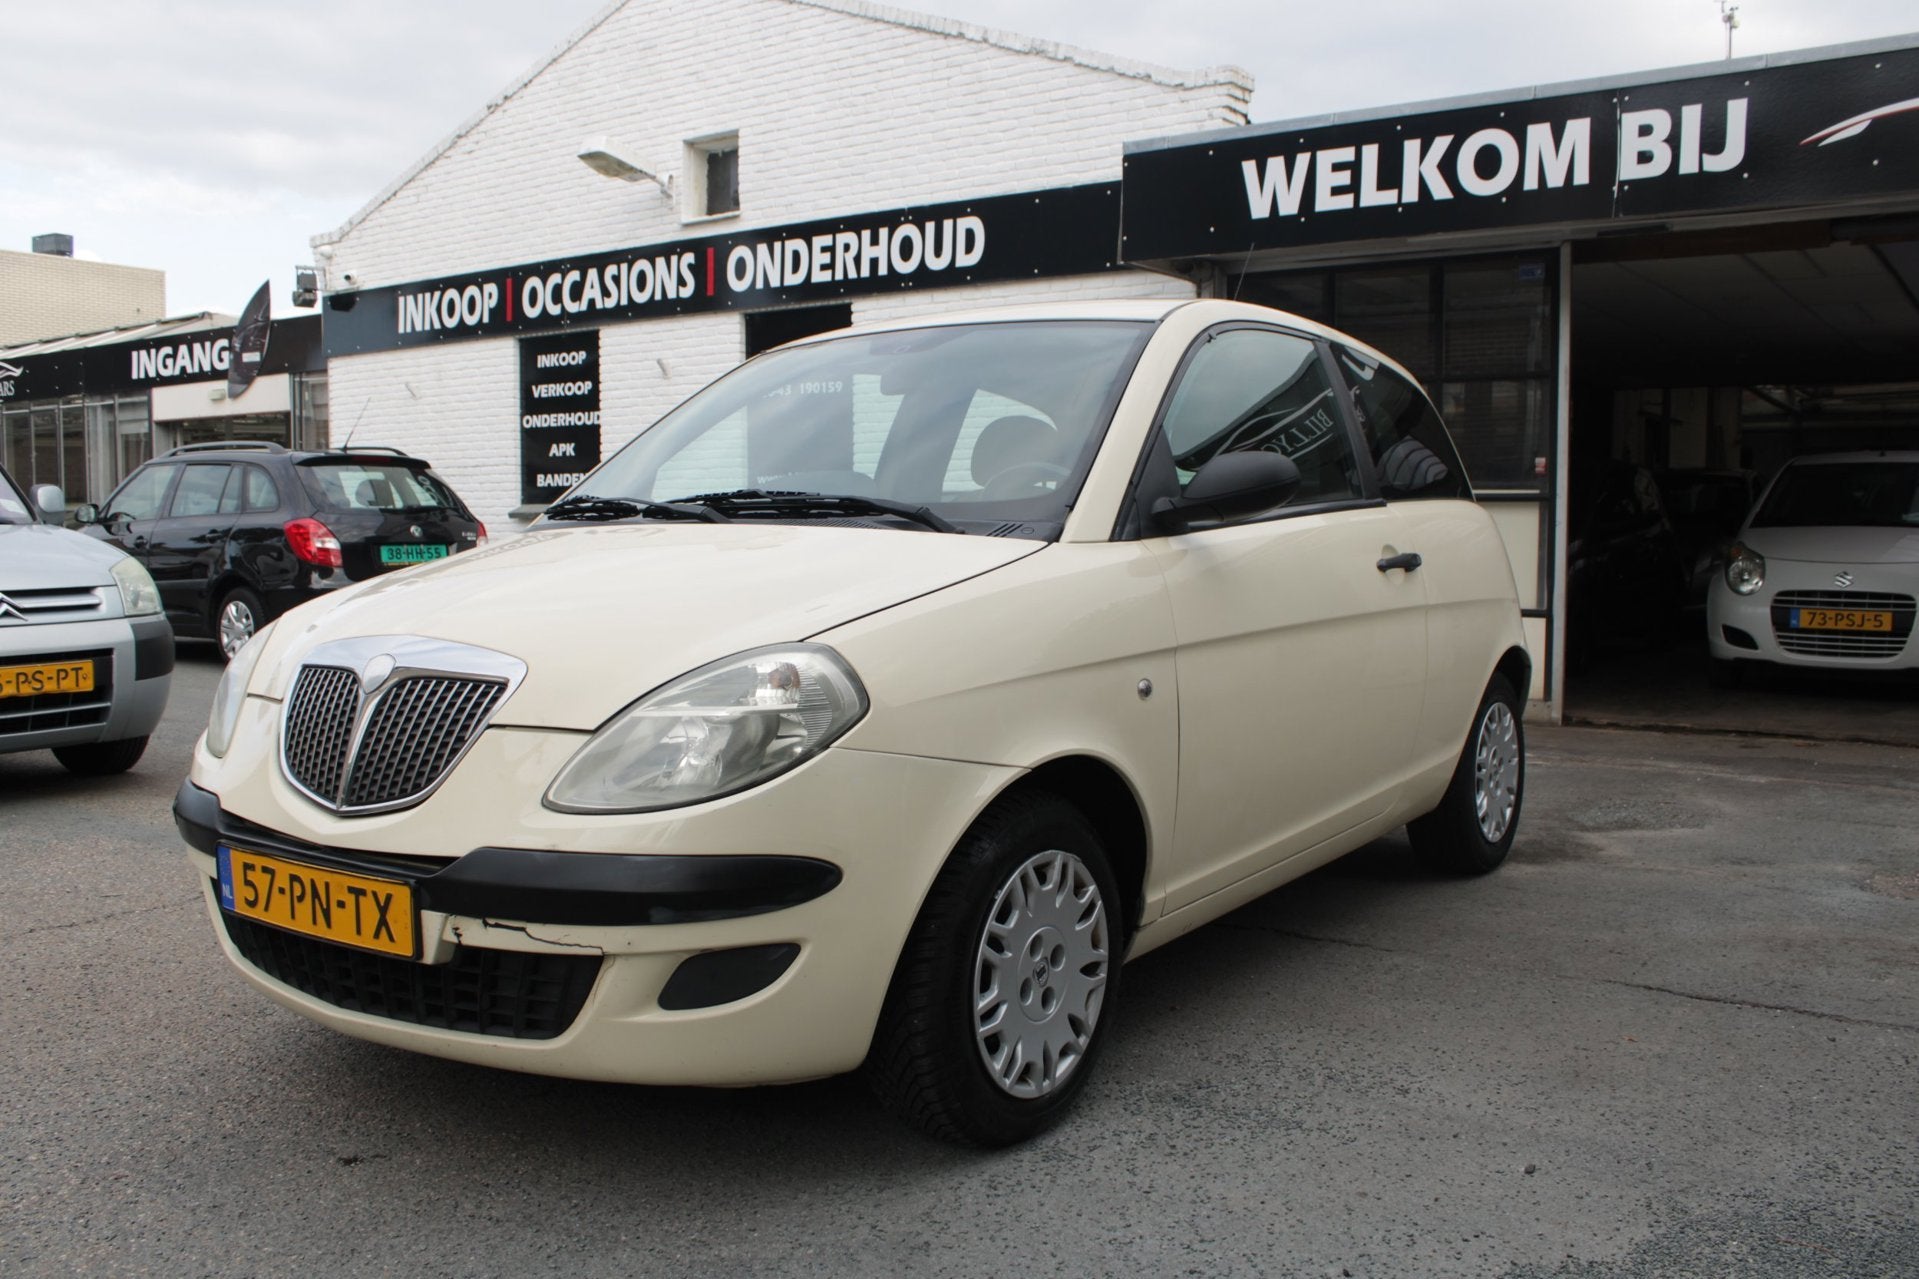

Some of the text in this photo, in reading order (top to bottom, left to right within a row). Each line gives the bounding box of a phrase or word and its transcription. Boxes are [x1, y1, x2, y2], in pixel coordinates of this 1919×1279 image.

[1241, 97, 1748, 220] WELKOM BIJ
[398, 215, 986, 334] INKOOP OCCASIONS ONDERHOUD
[131, 338, 230, 380] INGANG
[537, 351, 587, 368] INKOOP
[532, 381, 592, 398] VERKOOP
[800, 381, 843, 394] 190159
[522, 410, 601, 429] ONDERHOUD
[549, 443, 576, 457] APK
[387, 546, 441, 561] 38-HH-55
[1807, 612, 1884, 628] 73-PSJ-5
[0, 667, 84, 694] -PS-PT
[222, 886, 233, 899] NL
[242, 861, 396, 943] 57-PN-TX
